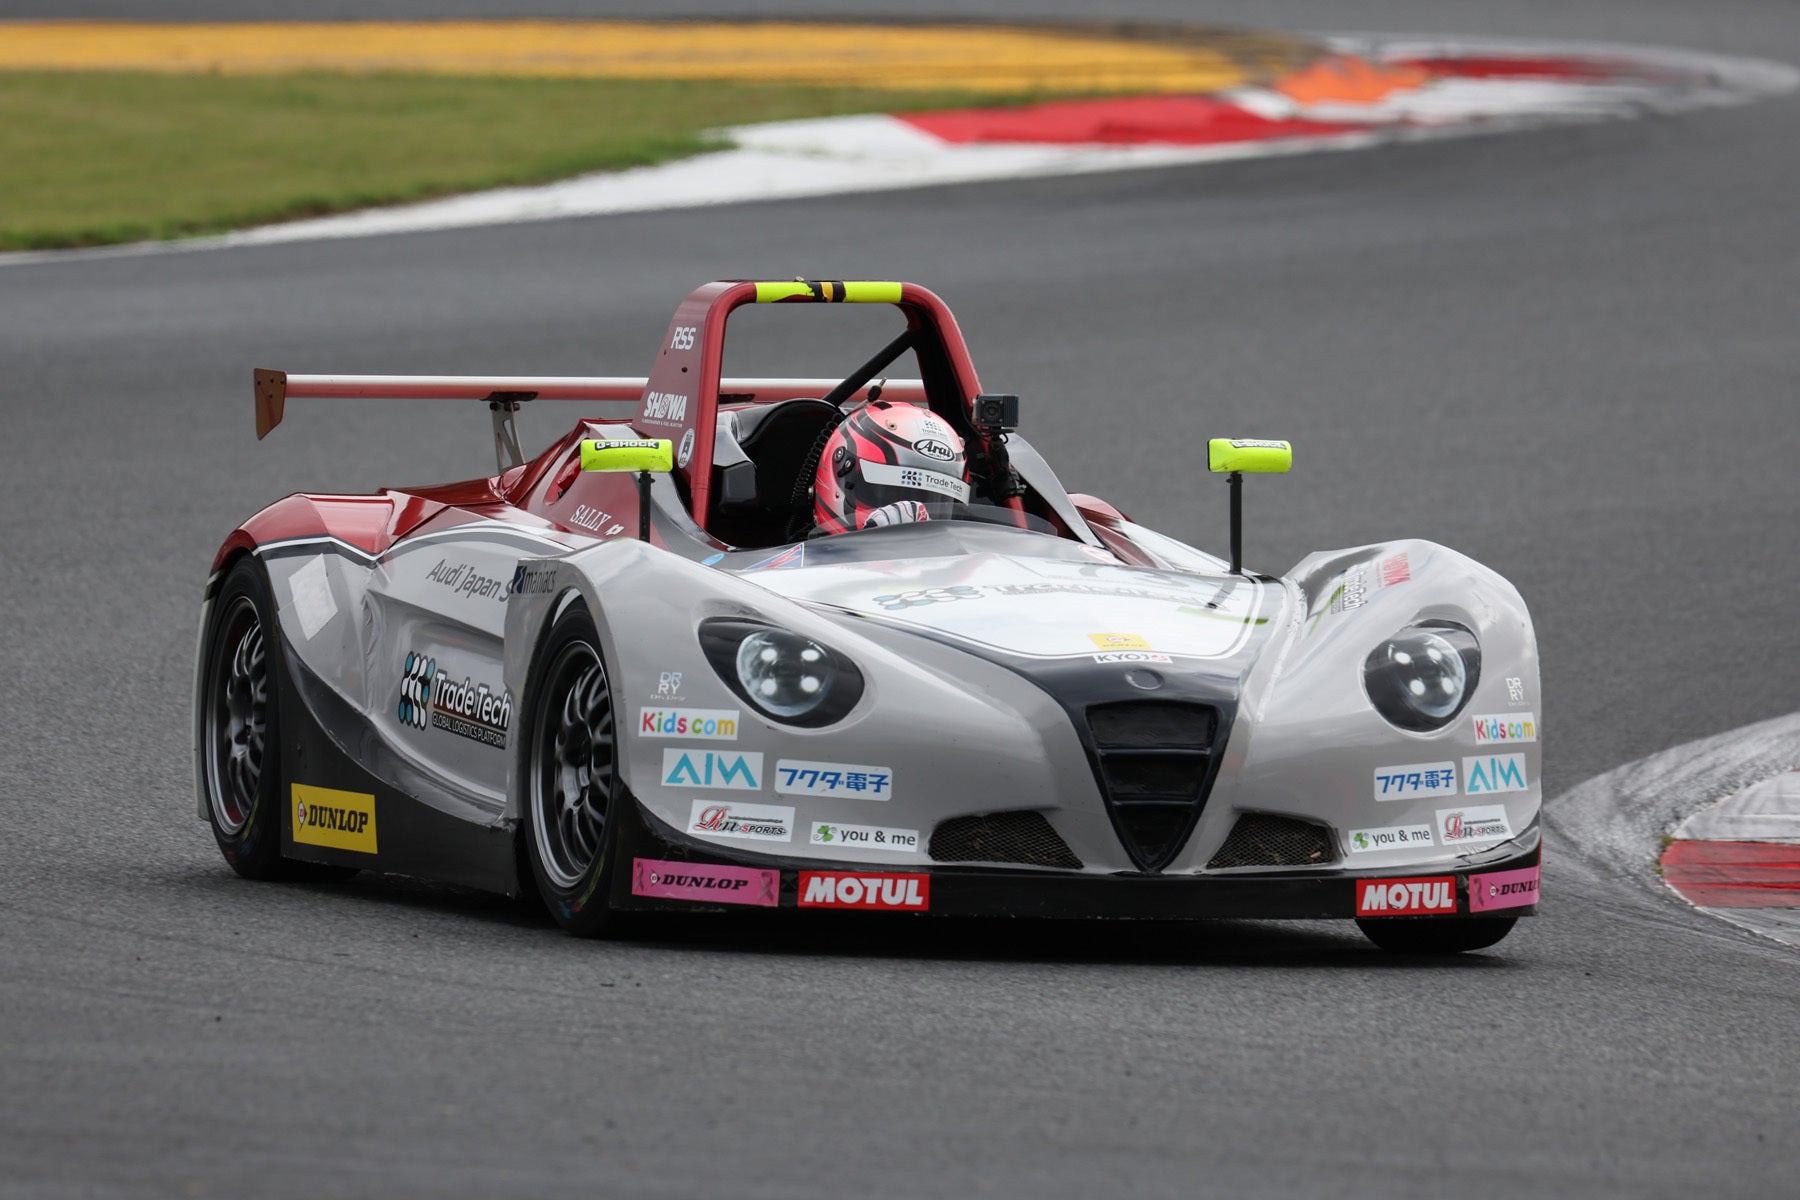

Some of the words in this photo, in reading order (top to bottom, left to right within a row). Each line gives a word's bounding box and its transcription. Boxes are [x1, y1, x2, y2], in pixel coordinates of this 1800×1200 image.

[670, 326, 696, 350] RSS
[643, 391, 688, 421] SHOWA
[596, 441, 658, 449] G-SHOCK
[917, 440, 951, 457] Arai
[569, 504, 612, 531] SALLY
[426, 558, 467, 587] Audi
[454, 566, 502, 599] Japan
[432, 712, 451, 730] GLOBAL
[452, 719, 477, 738] LOGISTICS
[665, 752, 758, 787] AIM
[779, 768, 889, 793] フクダ電子
[1376, 769, 1454, 793] フクダ電子
[1467, 757, 1525, 792] AIM
[308, 804, 369, 834] DUNLOP
[840, 829, 868, 843] you
[874, 830, 886, 843] &
[892, 834, 916, 847] me
[1372, 831, 1395, 847] you
[1399, 829, 1409, 842] &
[1412, 829, 1431, 841] me
[662, 874, 748, 890] DUNLOP
[803, 876, 923, 906] MOTUL
[1361, 882, 1453, 911] MOTUL
